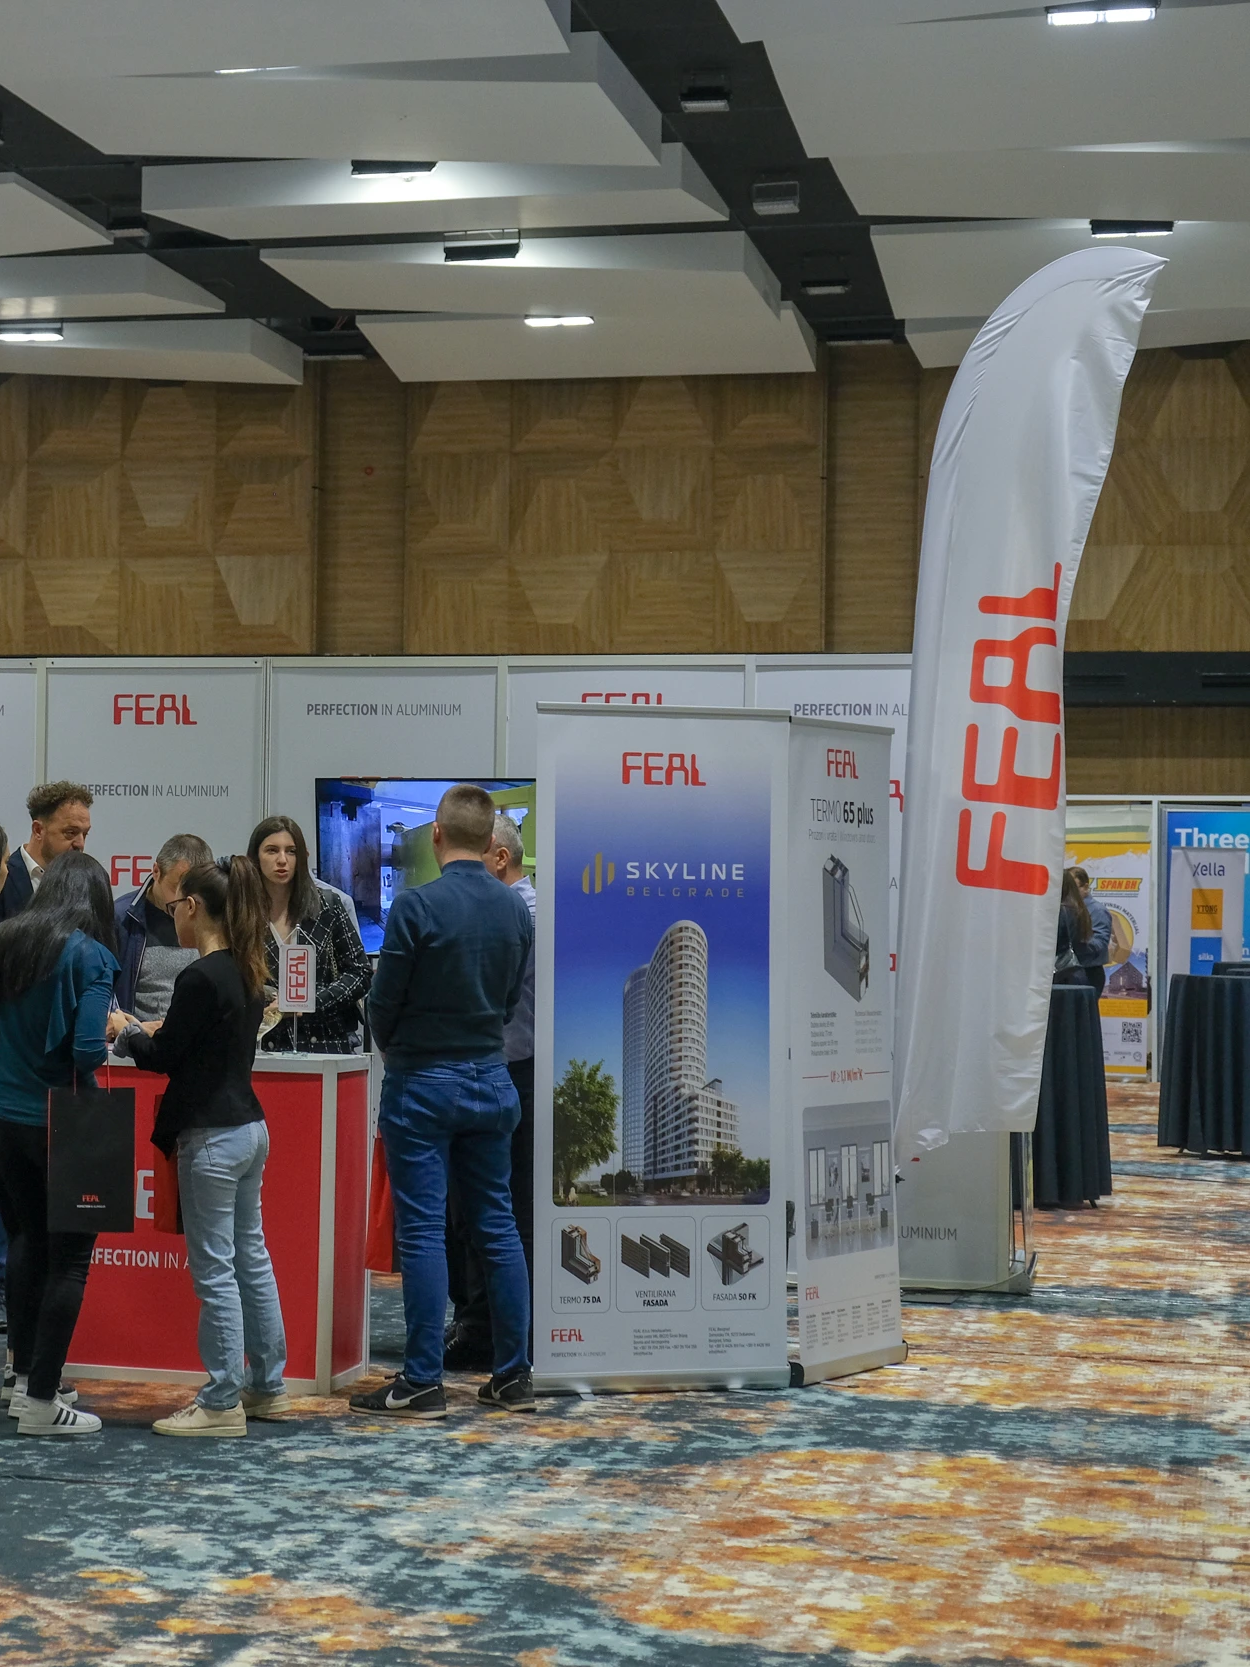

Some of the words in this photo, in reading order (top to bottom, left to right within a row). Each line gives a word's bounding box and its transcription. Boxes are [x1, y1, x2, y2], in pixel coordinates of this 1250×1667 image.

[113, 694, 198, 725] FEAL
[306, 703, 378, 716] PERFECTION
[381, 703, 393, 716] IN
[396, 703, 462, 716] ALUMINIUM
[793, 703, 872, 716] PERFECTION
[875, 703, 888, 716] IN
[955, 561, 1062, 896] FEAL
[621, 751, 707, 787] FEAL
[826, 748, 859, 780] FEAL
[152, 785, 163, 797] IN
[166, 785, 229, 798] ALUMINIUM
[810, 798, 842, 823] TERMO
[843, 801, 855, 824] 65
[857, 802, 874, 828] plus
[1174, 827, 1250, 849] Three
[111, 855, 152, 887] FE
[626, 862, 745, 881] SKYLINE
[1192, 862, 1226, 877] Xella
[1100, 879, 1124, 890] SPAN
[1124, 880, 1139, 890] BH
[626, 887, 745, 898] BELGRADE
[1196, 904, 1218, 913] YTONG
[1122, 907, 1140, 936] MATERIJAL
[1197, 952, 1214, 961] silka
[288, 951, 307, 1000] FEAL
[82, 1194, 100, 1203] FEAL
[898, 1226, 957, 1241] UMINIUM
[90, 1248, 159, 1268] FECTION
[164, 1252, 179, 1269] IN
[559, 1296, 582, 1305] TERMO
[582, 1295, 591, 1304] 75
[592, 1295, 602, 1304] DA
[635, 1289, 676, 1299] VENTILIRANA
[712, 1292, 737, 1301] FASADA
[738, 1293, 747, 1301] 50
[748, 1292, 757, 1300] FK
[805, 1286, 820, 1301] FEAL
[642, 1299, 669, 1307] FASADA
[551, 1328, 585, 1343] FEAL
